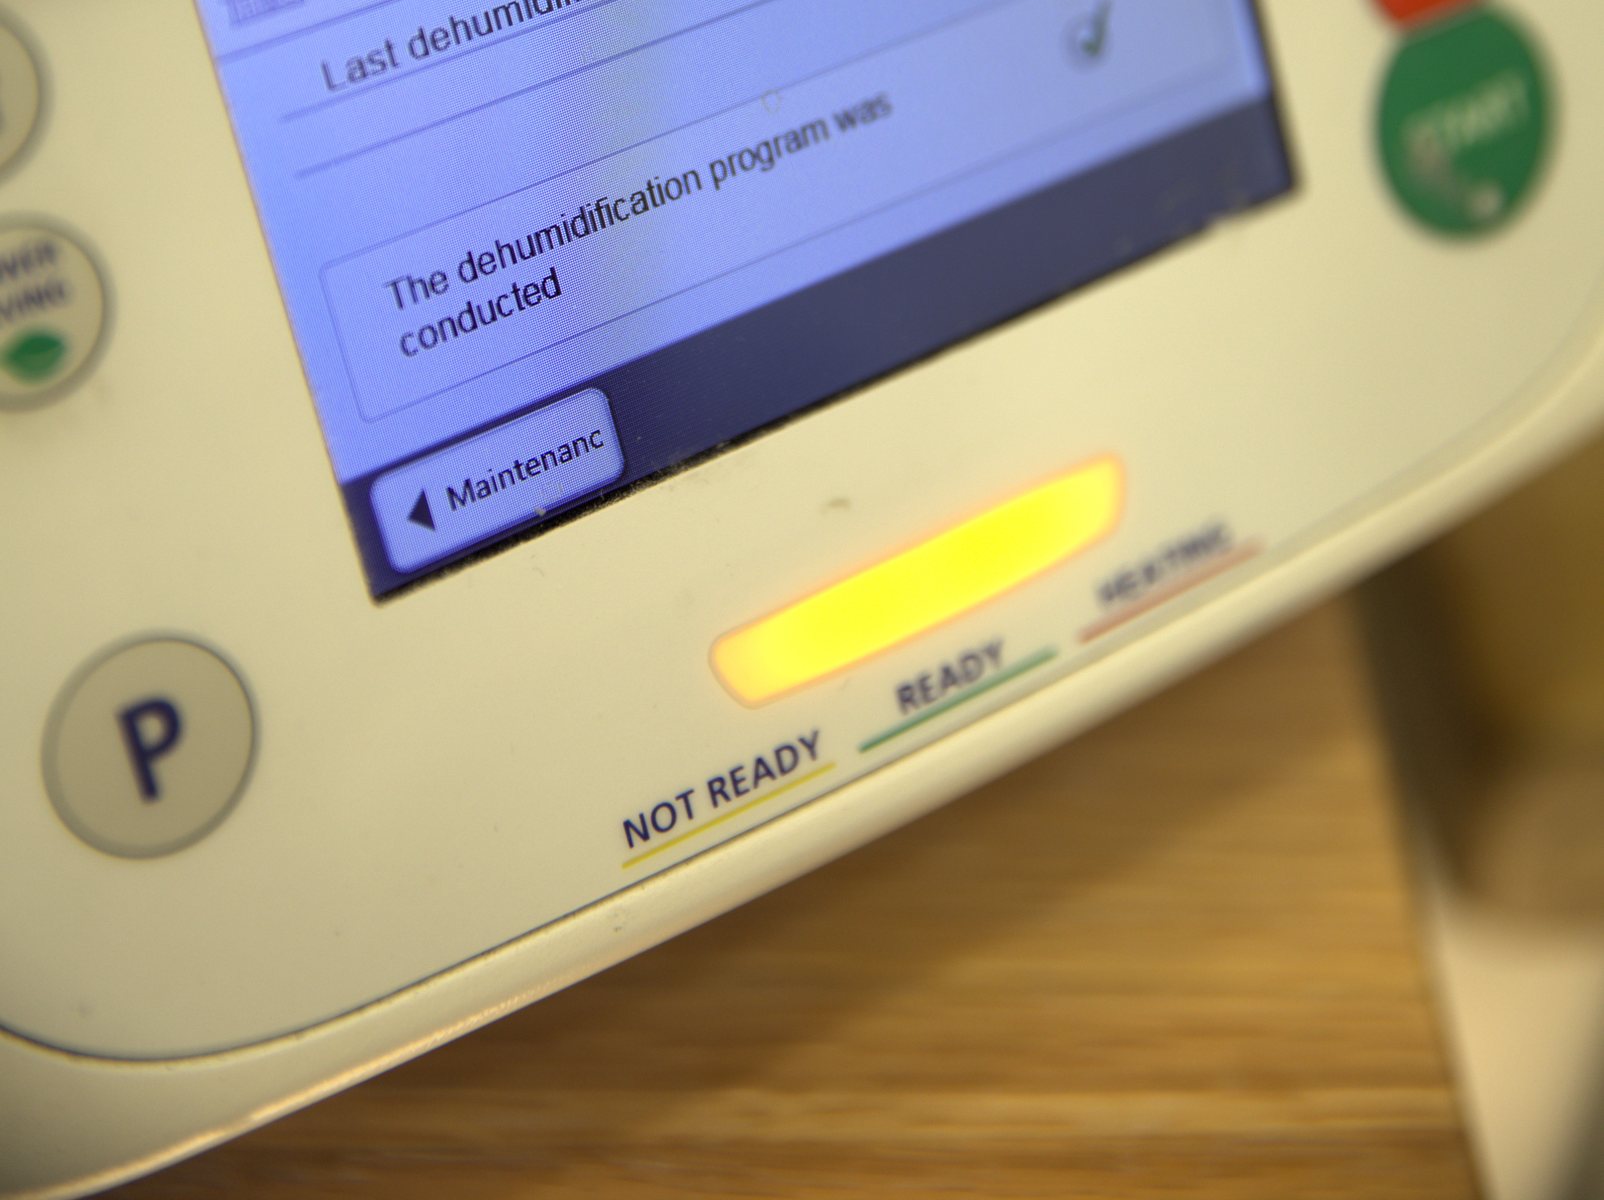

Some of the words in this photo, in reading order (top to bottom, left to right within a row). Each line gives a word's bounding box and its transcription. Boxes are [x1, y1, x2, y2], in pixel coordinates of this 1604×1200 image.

[320, 38, 398, 92] Last
[386, 271, 450, 312] The
[456, 166, 703, 286] dehumidification
[708, 113, 831, 191] program
[835, 91, 895, 137] was
[399, 265, 563, 359] conducted
[446, 424, 605, 513] Maintenanc
[894, 640, 1003, 714] READY
[118, 697, 182, 804] P
[621, 789, 697, 849] NOT
[707, 731, 823, 809] READY
